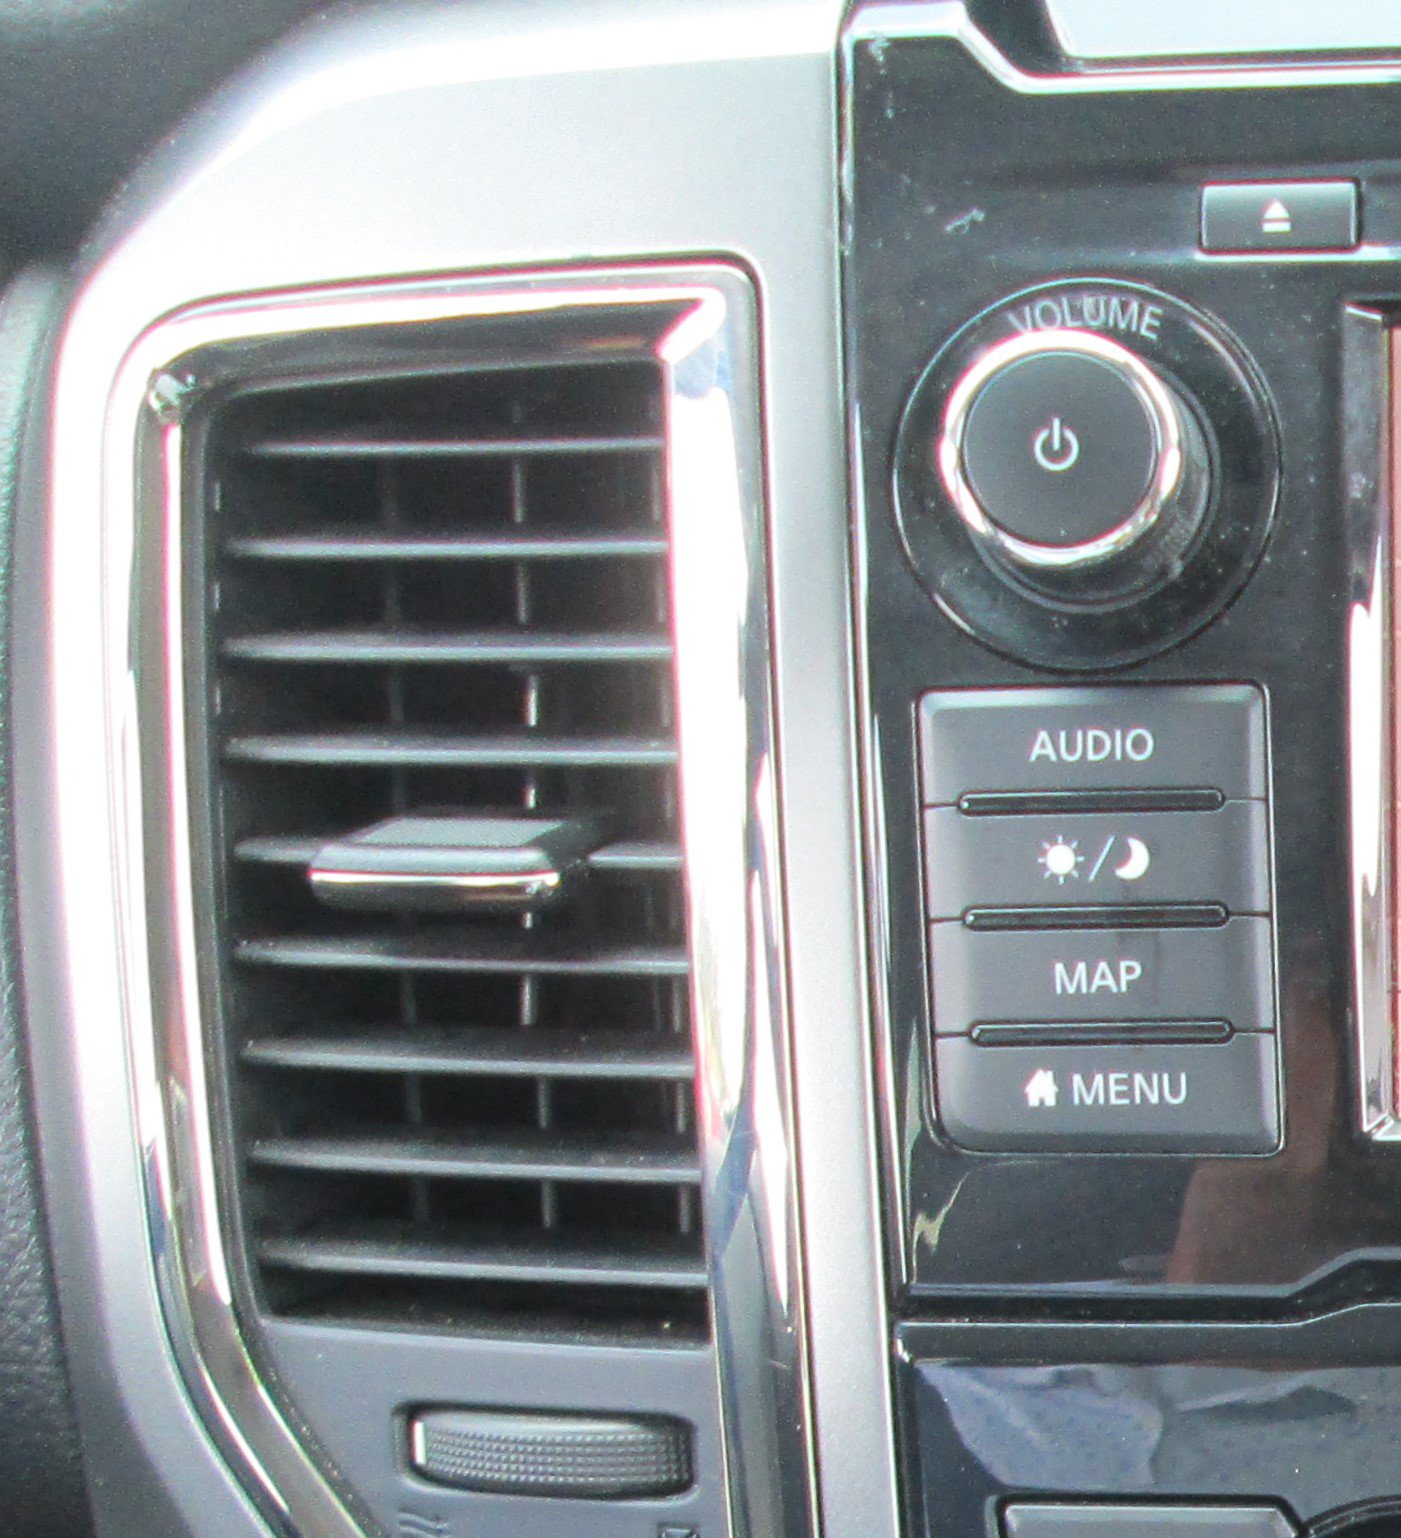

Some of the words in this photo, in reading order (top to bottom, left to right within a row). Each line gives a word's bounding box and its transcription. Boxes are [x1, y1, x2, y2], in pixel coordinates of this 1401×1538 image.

[1006, 296, 1163, 340] VOLUME
[1029, 728, 1154, 763] AUDIO
[1054, 960, 1142, 994] MAP
[1072, 1073, 1188, 1106] MENU
